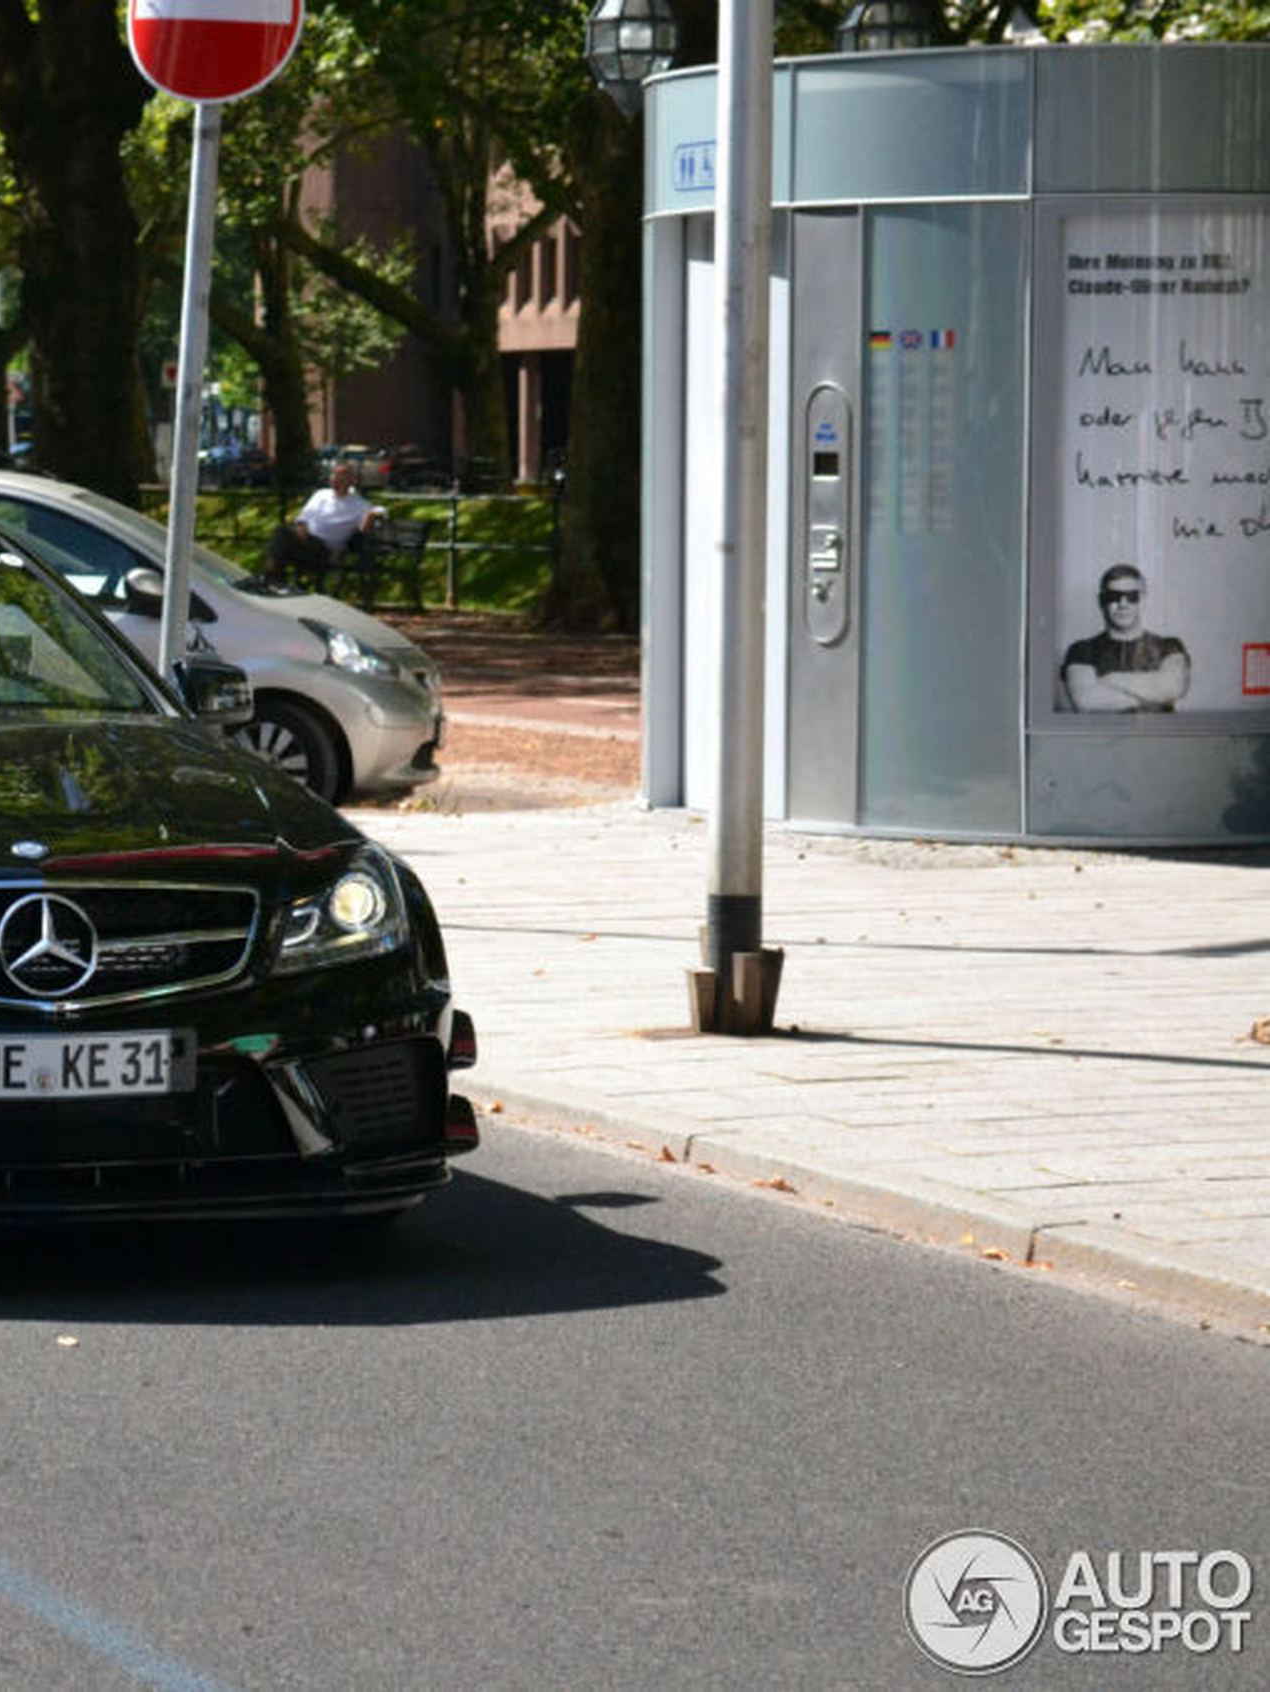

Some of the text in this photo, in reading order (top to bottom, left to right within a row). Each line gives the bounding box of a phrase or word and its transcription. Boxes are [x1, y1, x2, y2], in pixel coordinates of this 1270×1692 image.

[1080, 405, 1132, 427] oder
[62, 1044, 109, 1088] KE
[121, 1041, 164, 1086] 31
